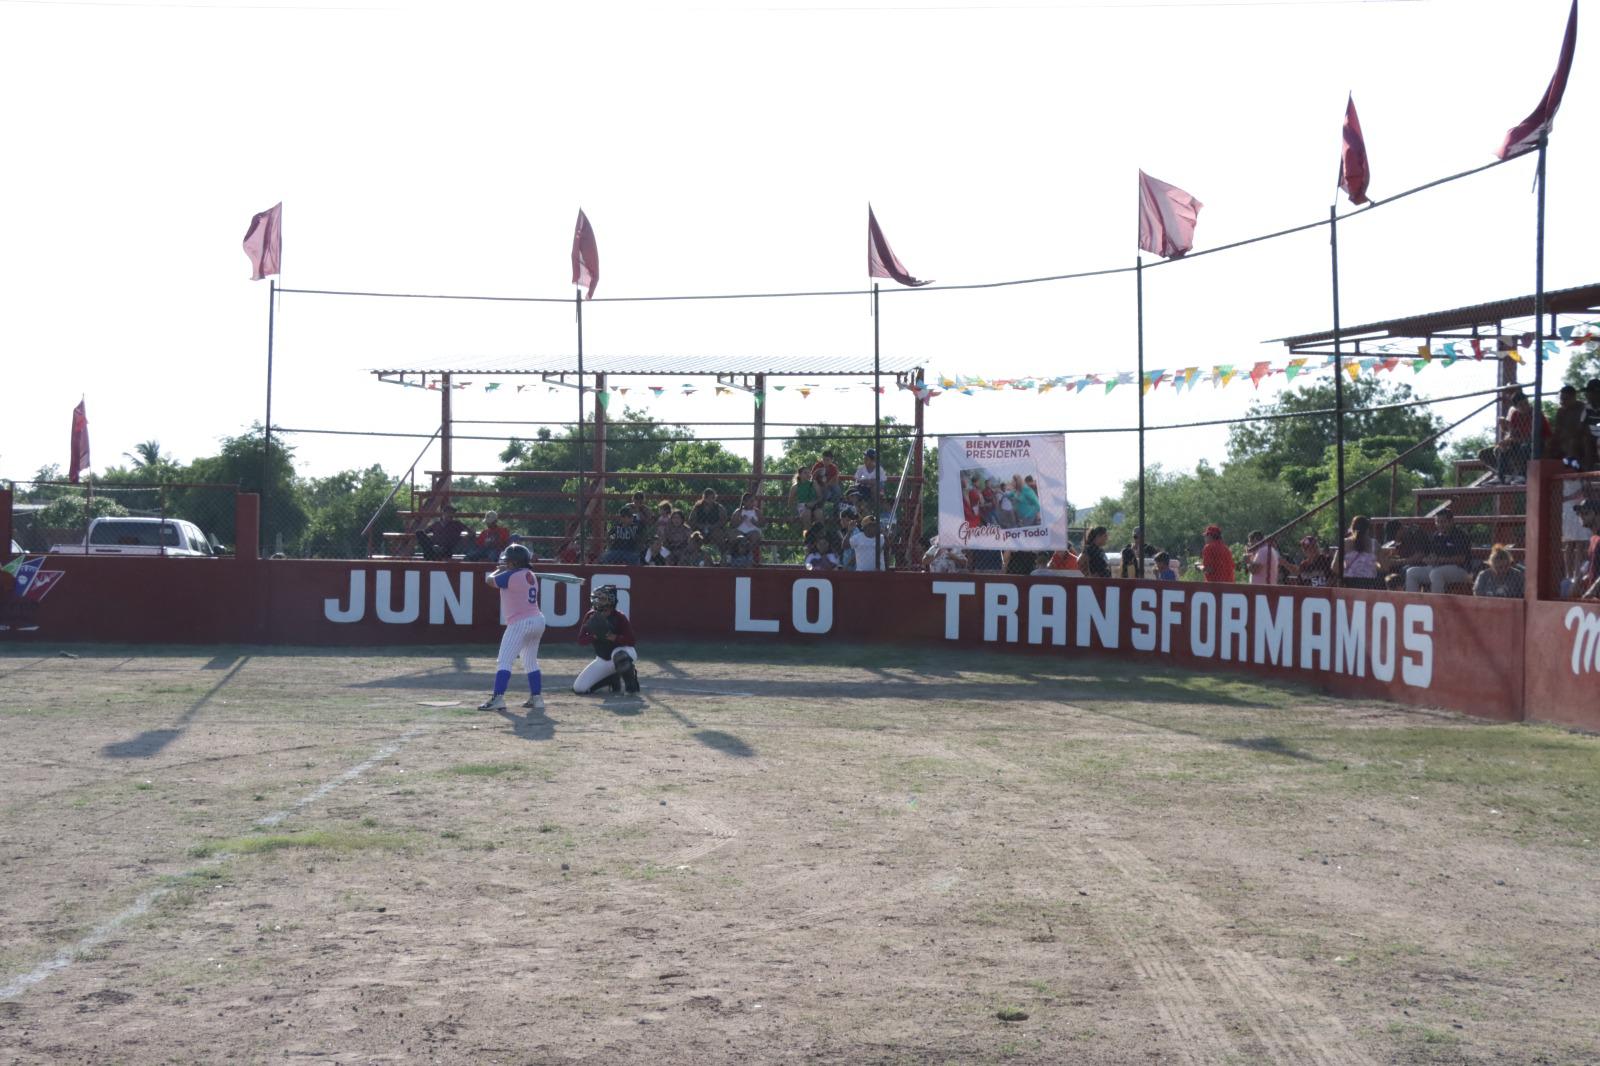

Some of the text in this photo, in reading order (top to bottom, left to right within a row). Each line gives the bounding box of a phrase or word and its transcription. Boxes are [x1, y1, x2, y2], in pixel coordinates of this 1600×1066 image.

[966, 439, 1031, 449] BIENVENIDA
[966, 449, 1030, 459] PRESIDENTA
[958, 521, 1000, 545] Gracias
[1023, 528, 1048, 537] Todo!
[528, 587, 537, 604] 9
[324, 569, 1435, 689] JUNOS LO TRANSFORMAMOS
